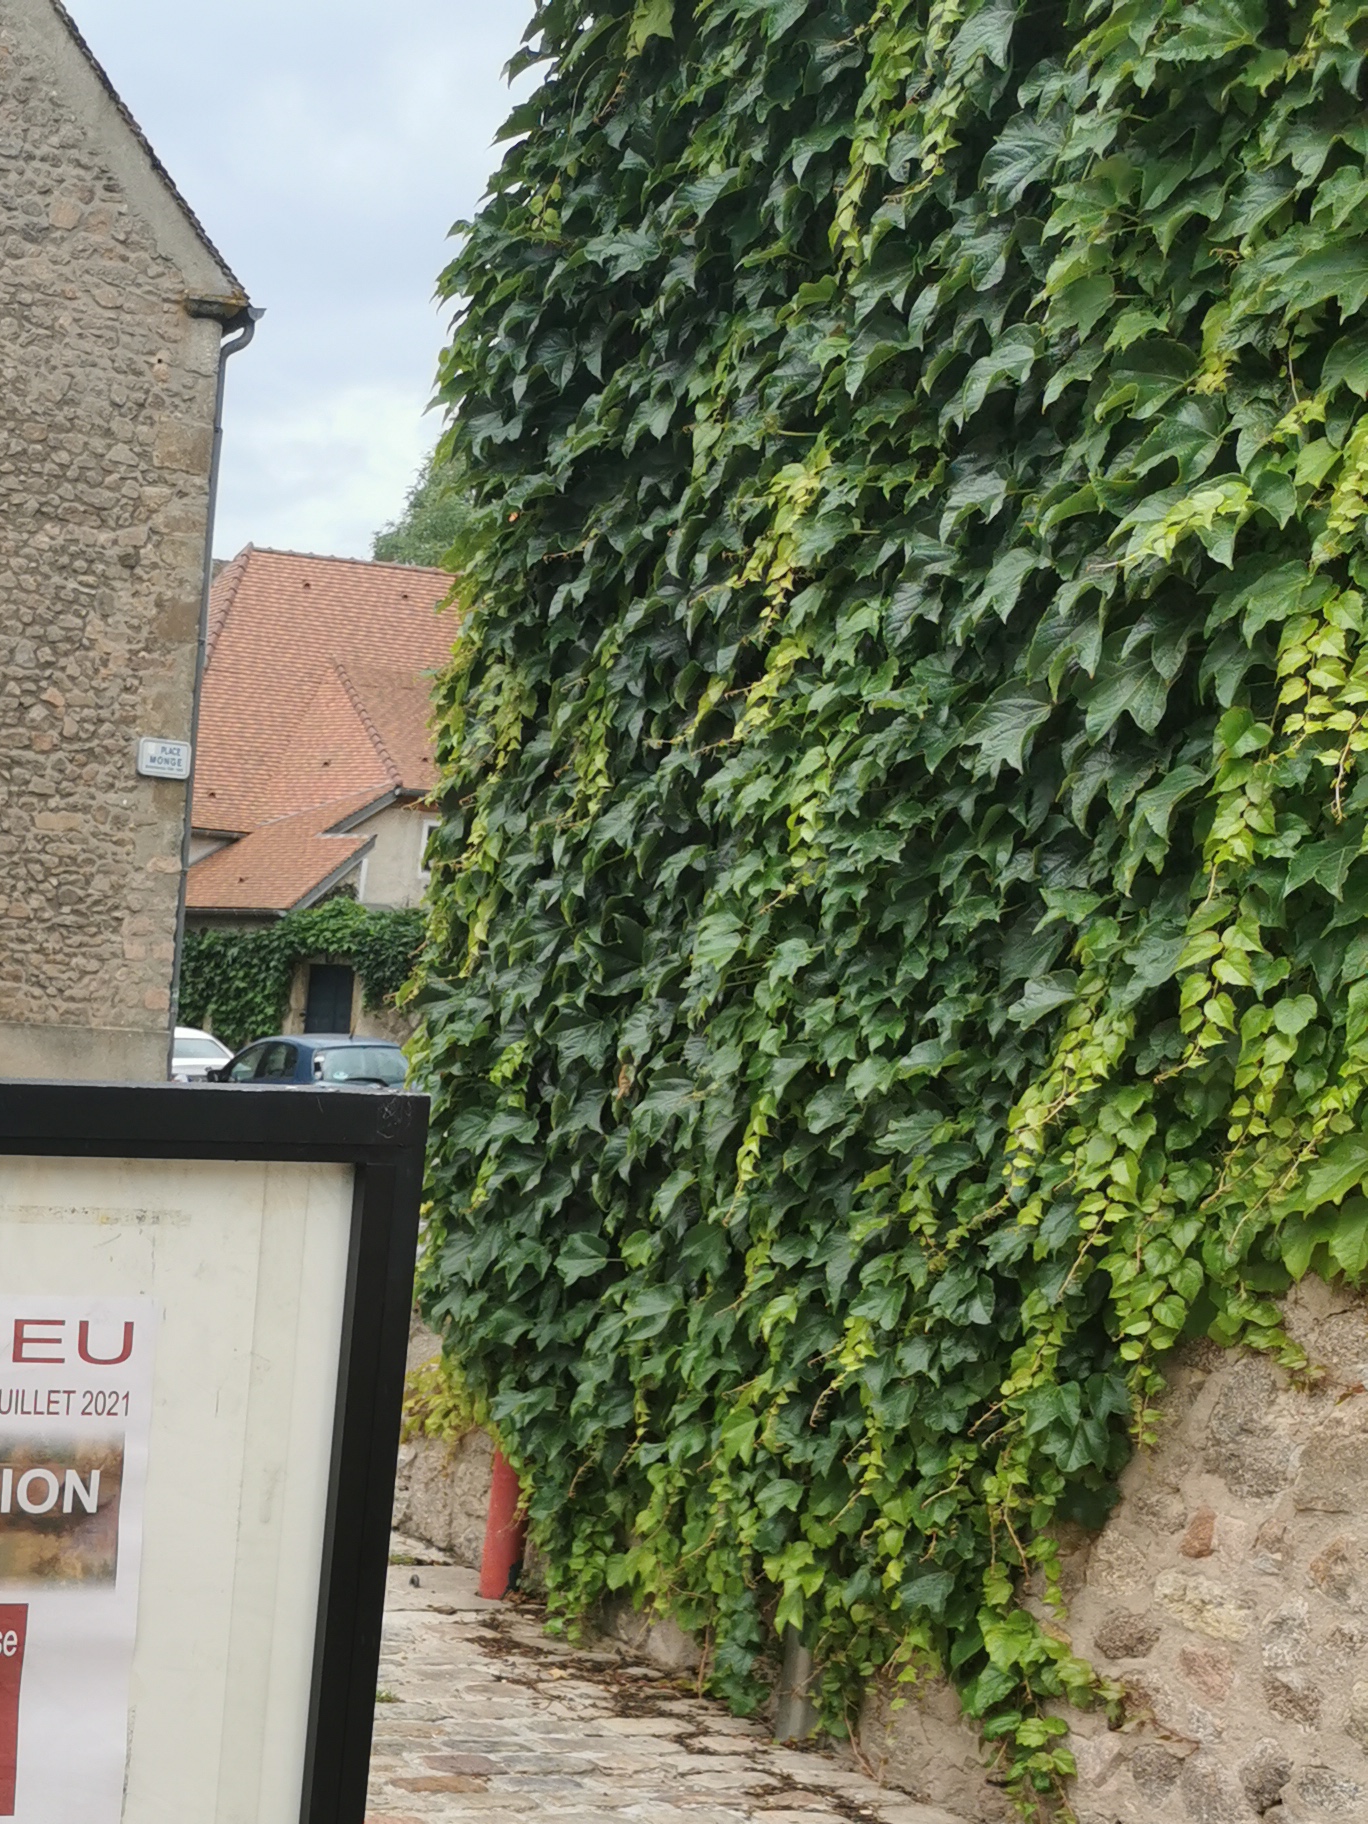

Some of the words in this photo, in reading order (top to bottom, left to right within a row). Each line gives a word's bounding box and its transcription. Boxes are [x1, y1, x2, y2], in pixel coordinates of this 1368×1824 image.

[161, 747, 181, 756] PLACE
[150, 756, 182, 767] MONGE
[80, 1390, 130, 1417] 2021
